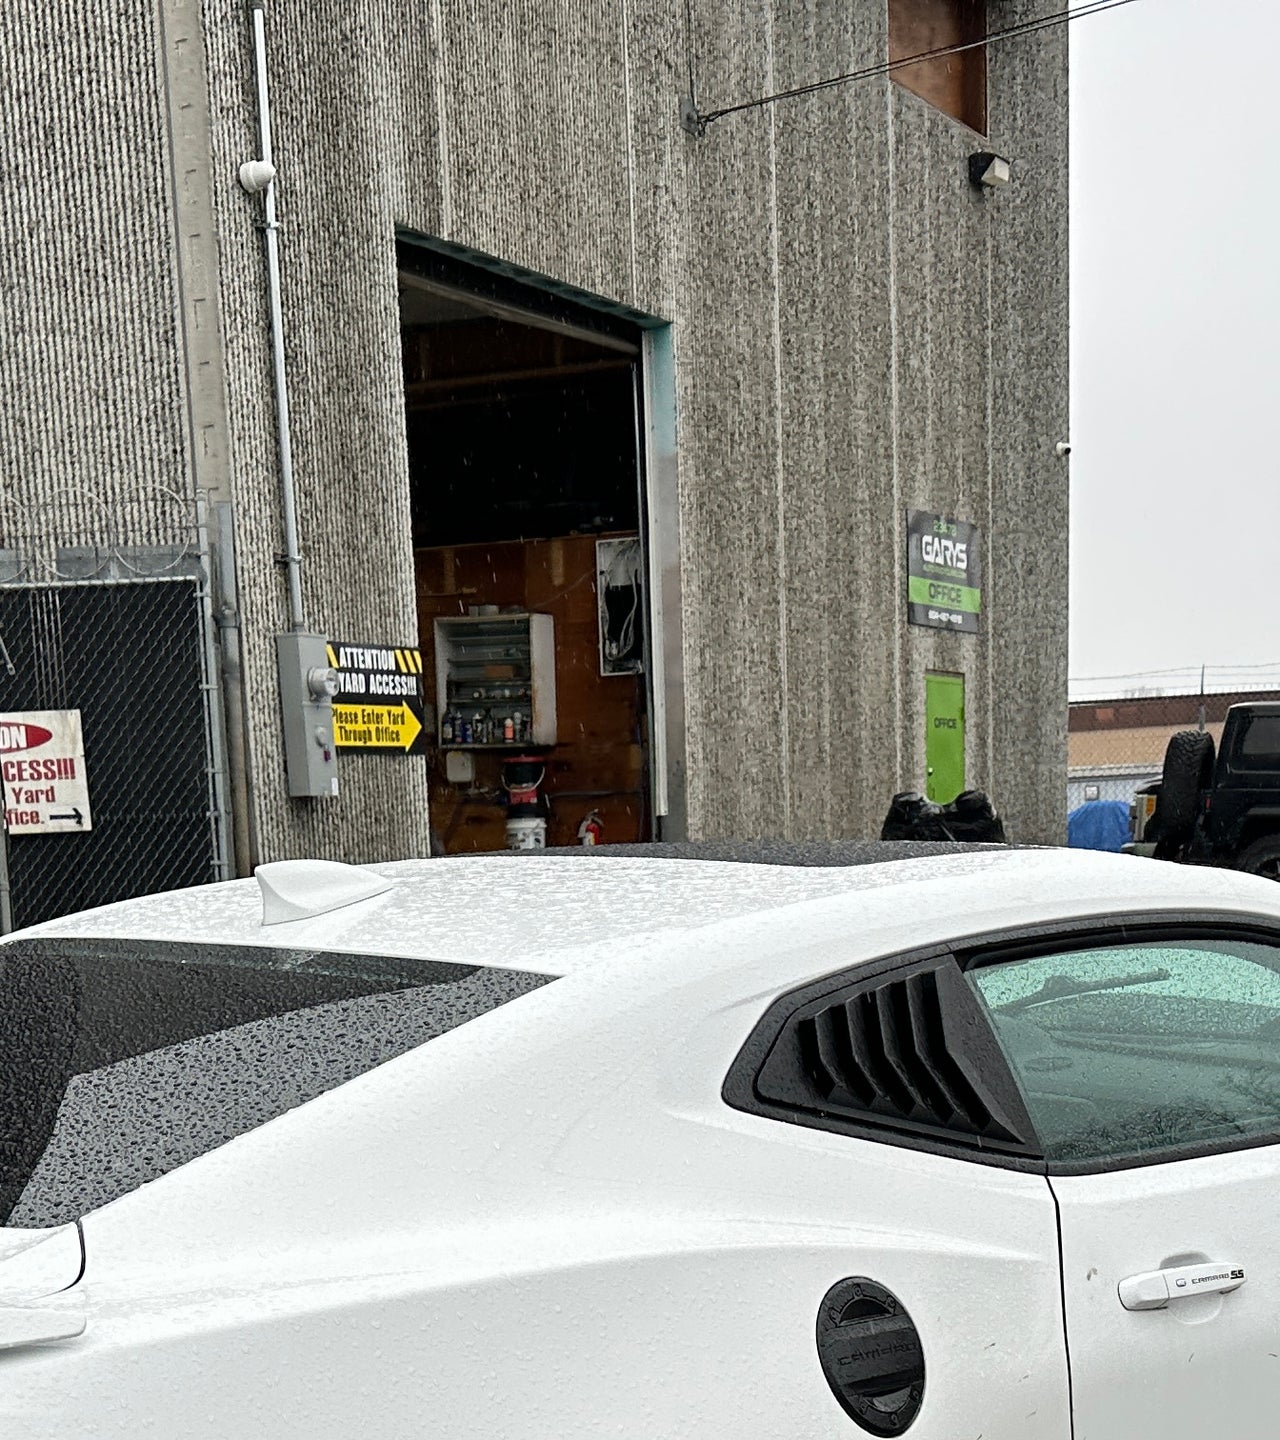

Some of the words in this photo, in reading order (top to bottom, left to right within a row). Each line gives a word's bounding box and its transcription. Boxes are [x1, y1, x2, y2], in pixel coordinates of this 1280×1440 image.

[922, 535, 968, 570] GARYS
[928, 583, 962, 604] OFFICE
[339, 647, 395, 670] ATTENTION
[339, 672, 366, 693] YARD
[369, 674, 417, 695] ACCESS!!!
[361, 709, 384, 725] Enter
[387, 710, 405, 725] Yard
[934, 717, 957, 729] OFFICE
[338, 726, 373, 744] Through
[375, 727, 400, 742] Office
[3, 758, 76, 782] CESS!!!
[11, 786, 56, 804] Yard
